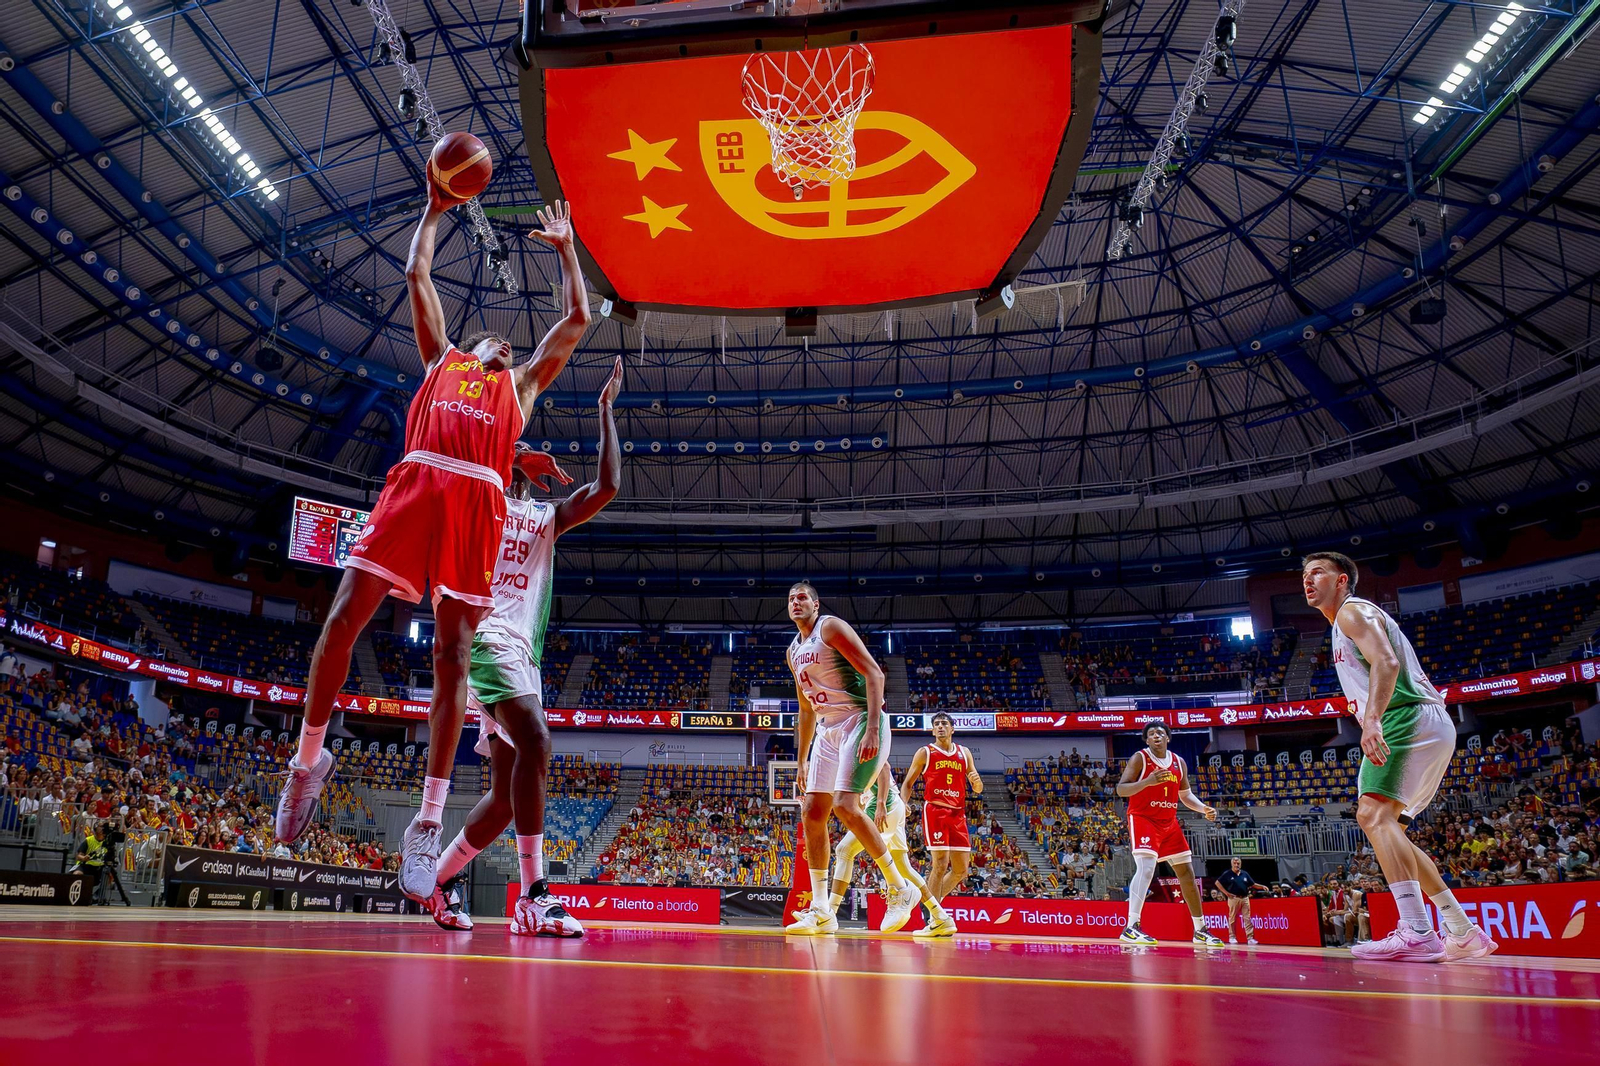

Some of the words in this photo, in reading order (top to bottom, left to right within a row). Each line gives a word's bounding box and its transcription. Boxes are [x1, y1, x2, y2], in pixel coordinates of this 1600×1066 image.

[716, 131, 745, 173] FEB
[446, 360, 498, 384] ESPAA
[458, 380, 484, 399] 13
[430, 400, 495, 425] endesa
[340, 509, 352, 518] 18
[359, 514, 370, 522] 28
[505, 515, 547, 539] RTUGAL
[503, 538, 529, 565] 29
[497, 589, 524, 602] eguros
[102, 650, 130, 664] IBERIA
[149, 663, 189, 678] azulmarino
[799, 670, 813, 687] 4
[1461, 678, 1519, 693] azulmarino
[1077, 714, 1125, 722] azulmarino
[1264, 705, 1314, 719] Andalucía
[607, 714, 645, 725] Andalucía
[690, 716, 724, 726] ESPAÑA
[726, 717, 733, 726] B
[757, 715, 772, 727] 18
[896, 715, 916, 728] 28
[952, 718, 989, 727] RTUGAL
[935, 759, 963, 773] ESPAÑA
[945, 774, 953, 785] 5
[1163, 786, 1168, 797] 1
[1150, 800, 1178, 809] endea
[202, 860, 232, 875] endesa
[316, 873, 335, 884] endesa
[747, 892, 783, 902] endesa
[611, 897, 653, 910] Talento
[656, 901, 664, 911] a
[666, 898, 699, 912] bordo
[1020, 910, 1072, 925] Talento
[1076, 915, 1085, 925] a
[1087, 912, 1127, 927] bordo
[1204, 915, 1230, 928] BERIA
[1269, 914, 1290, 929] bordo
